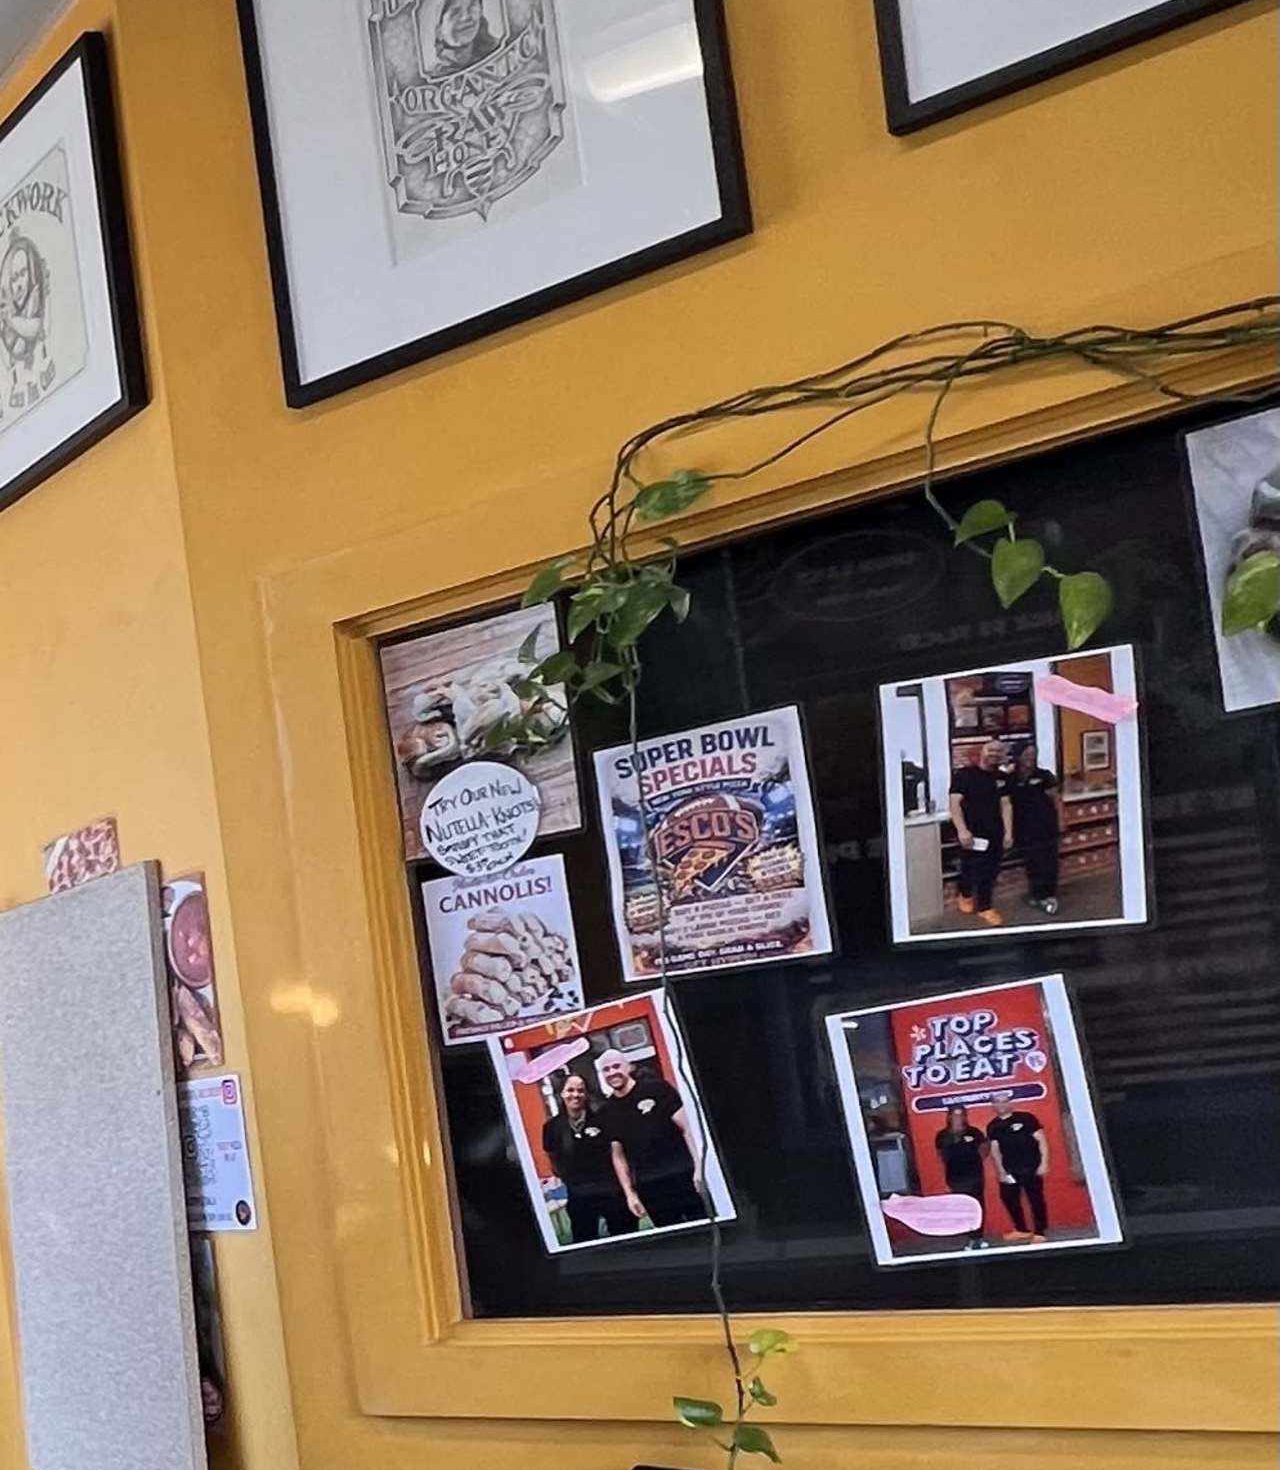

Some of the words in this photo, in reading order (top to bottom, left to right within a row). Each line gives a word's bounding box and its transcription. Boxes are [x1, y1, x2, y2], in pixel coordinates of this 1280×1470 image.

[614, 738, 694, 779] SUPER
[700, 726, 775, 755] BOWL
[639, 752, 758, 796] SPECIALS
[440, 876, 553, 914] CANNOLIS!
[931, 1011, 996, 1040] TOP
[914, 1030, 1036, 1063] PLACES
[905, 1064, 950, 1087] TO
[955, 1053, 1017, 1081] EAT
